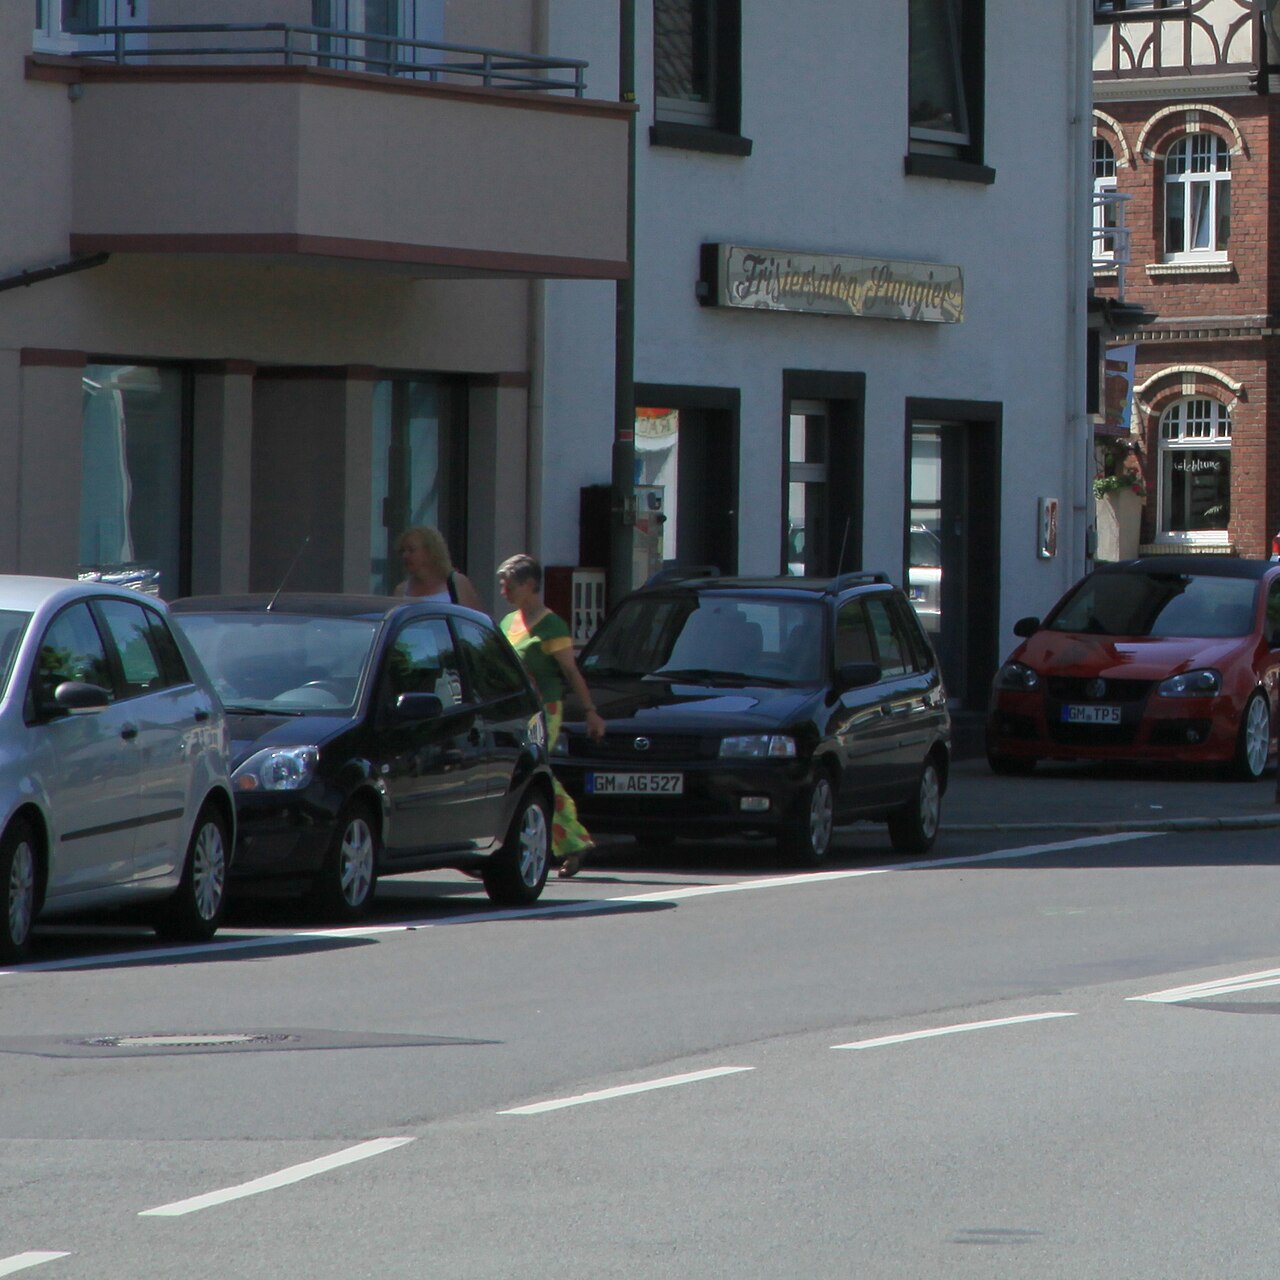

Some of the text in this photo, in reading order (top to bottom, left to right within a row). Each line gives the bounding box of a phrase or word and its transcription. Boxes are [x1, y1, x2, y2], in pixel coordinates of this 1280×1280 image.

[1068, 706, 1086, 721] GM
[1094, 707, 1110, 721] TP
[594, 775, 680, 792] GM AG 527
